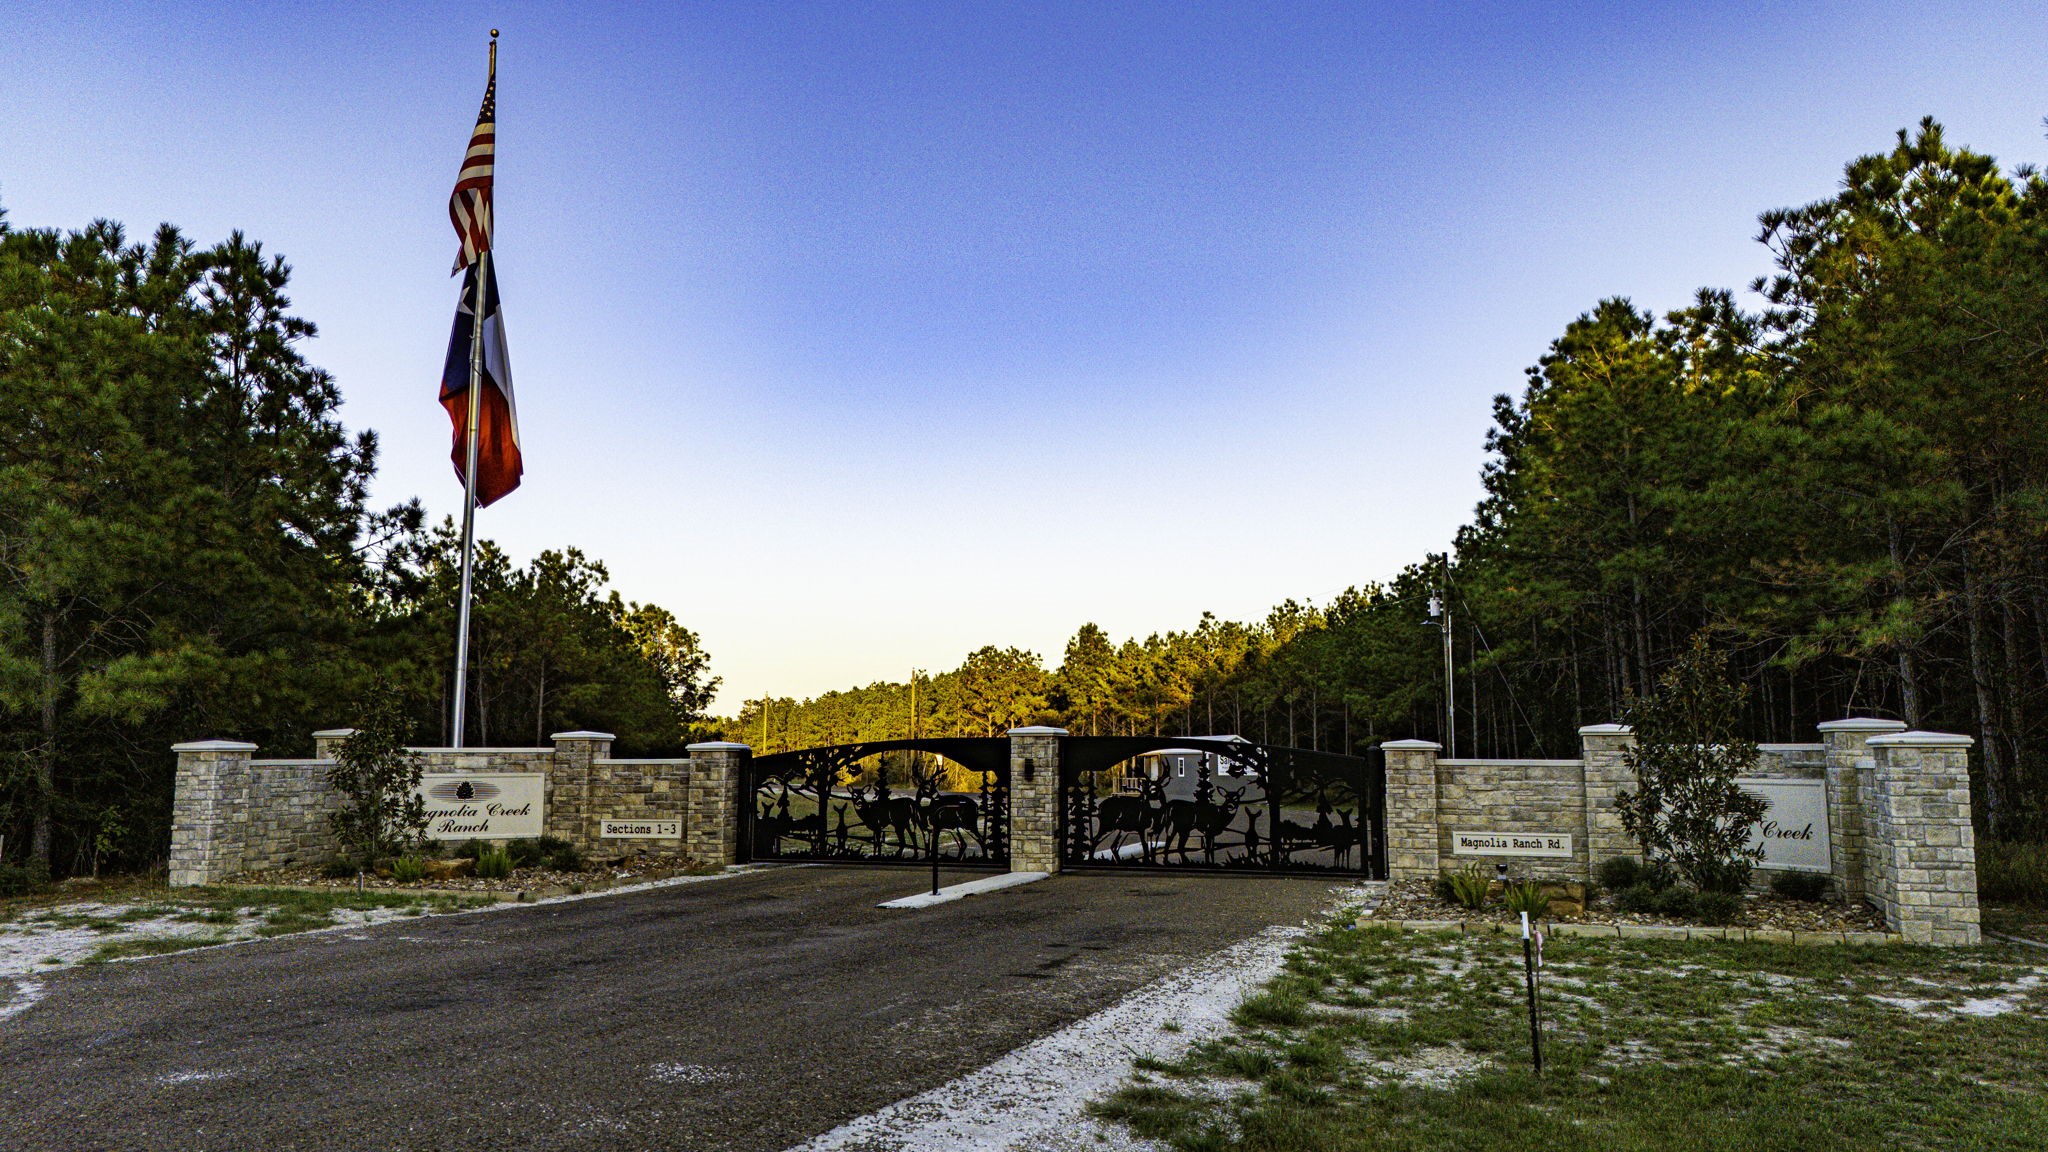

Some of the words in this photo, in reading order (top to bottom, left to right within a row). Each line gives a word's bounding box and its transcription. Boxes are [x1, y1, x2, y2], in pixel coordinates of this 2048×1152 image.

[486, 803, 531, 816] Creek
[437, 819, 489, 833] Ranch
[606, 823, 652, 834] Sections
[657, 824, 677, 834] 1-3
[1759, 820, 1813, 840] Creek
[1460, 838, 1507, 850] Magnolia
[1512, 839, 1543, 849] Ranch
[1547, 840, 1565, 849] Rd.
